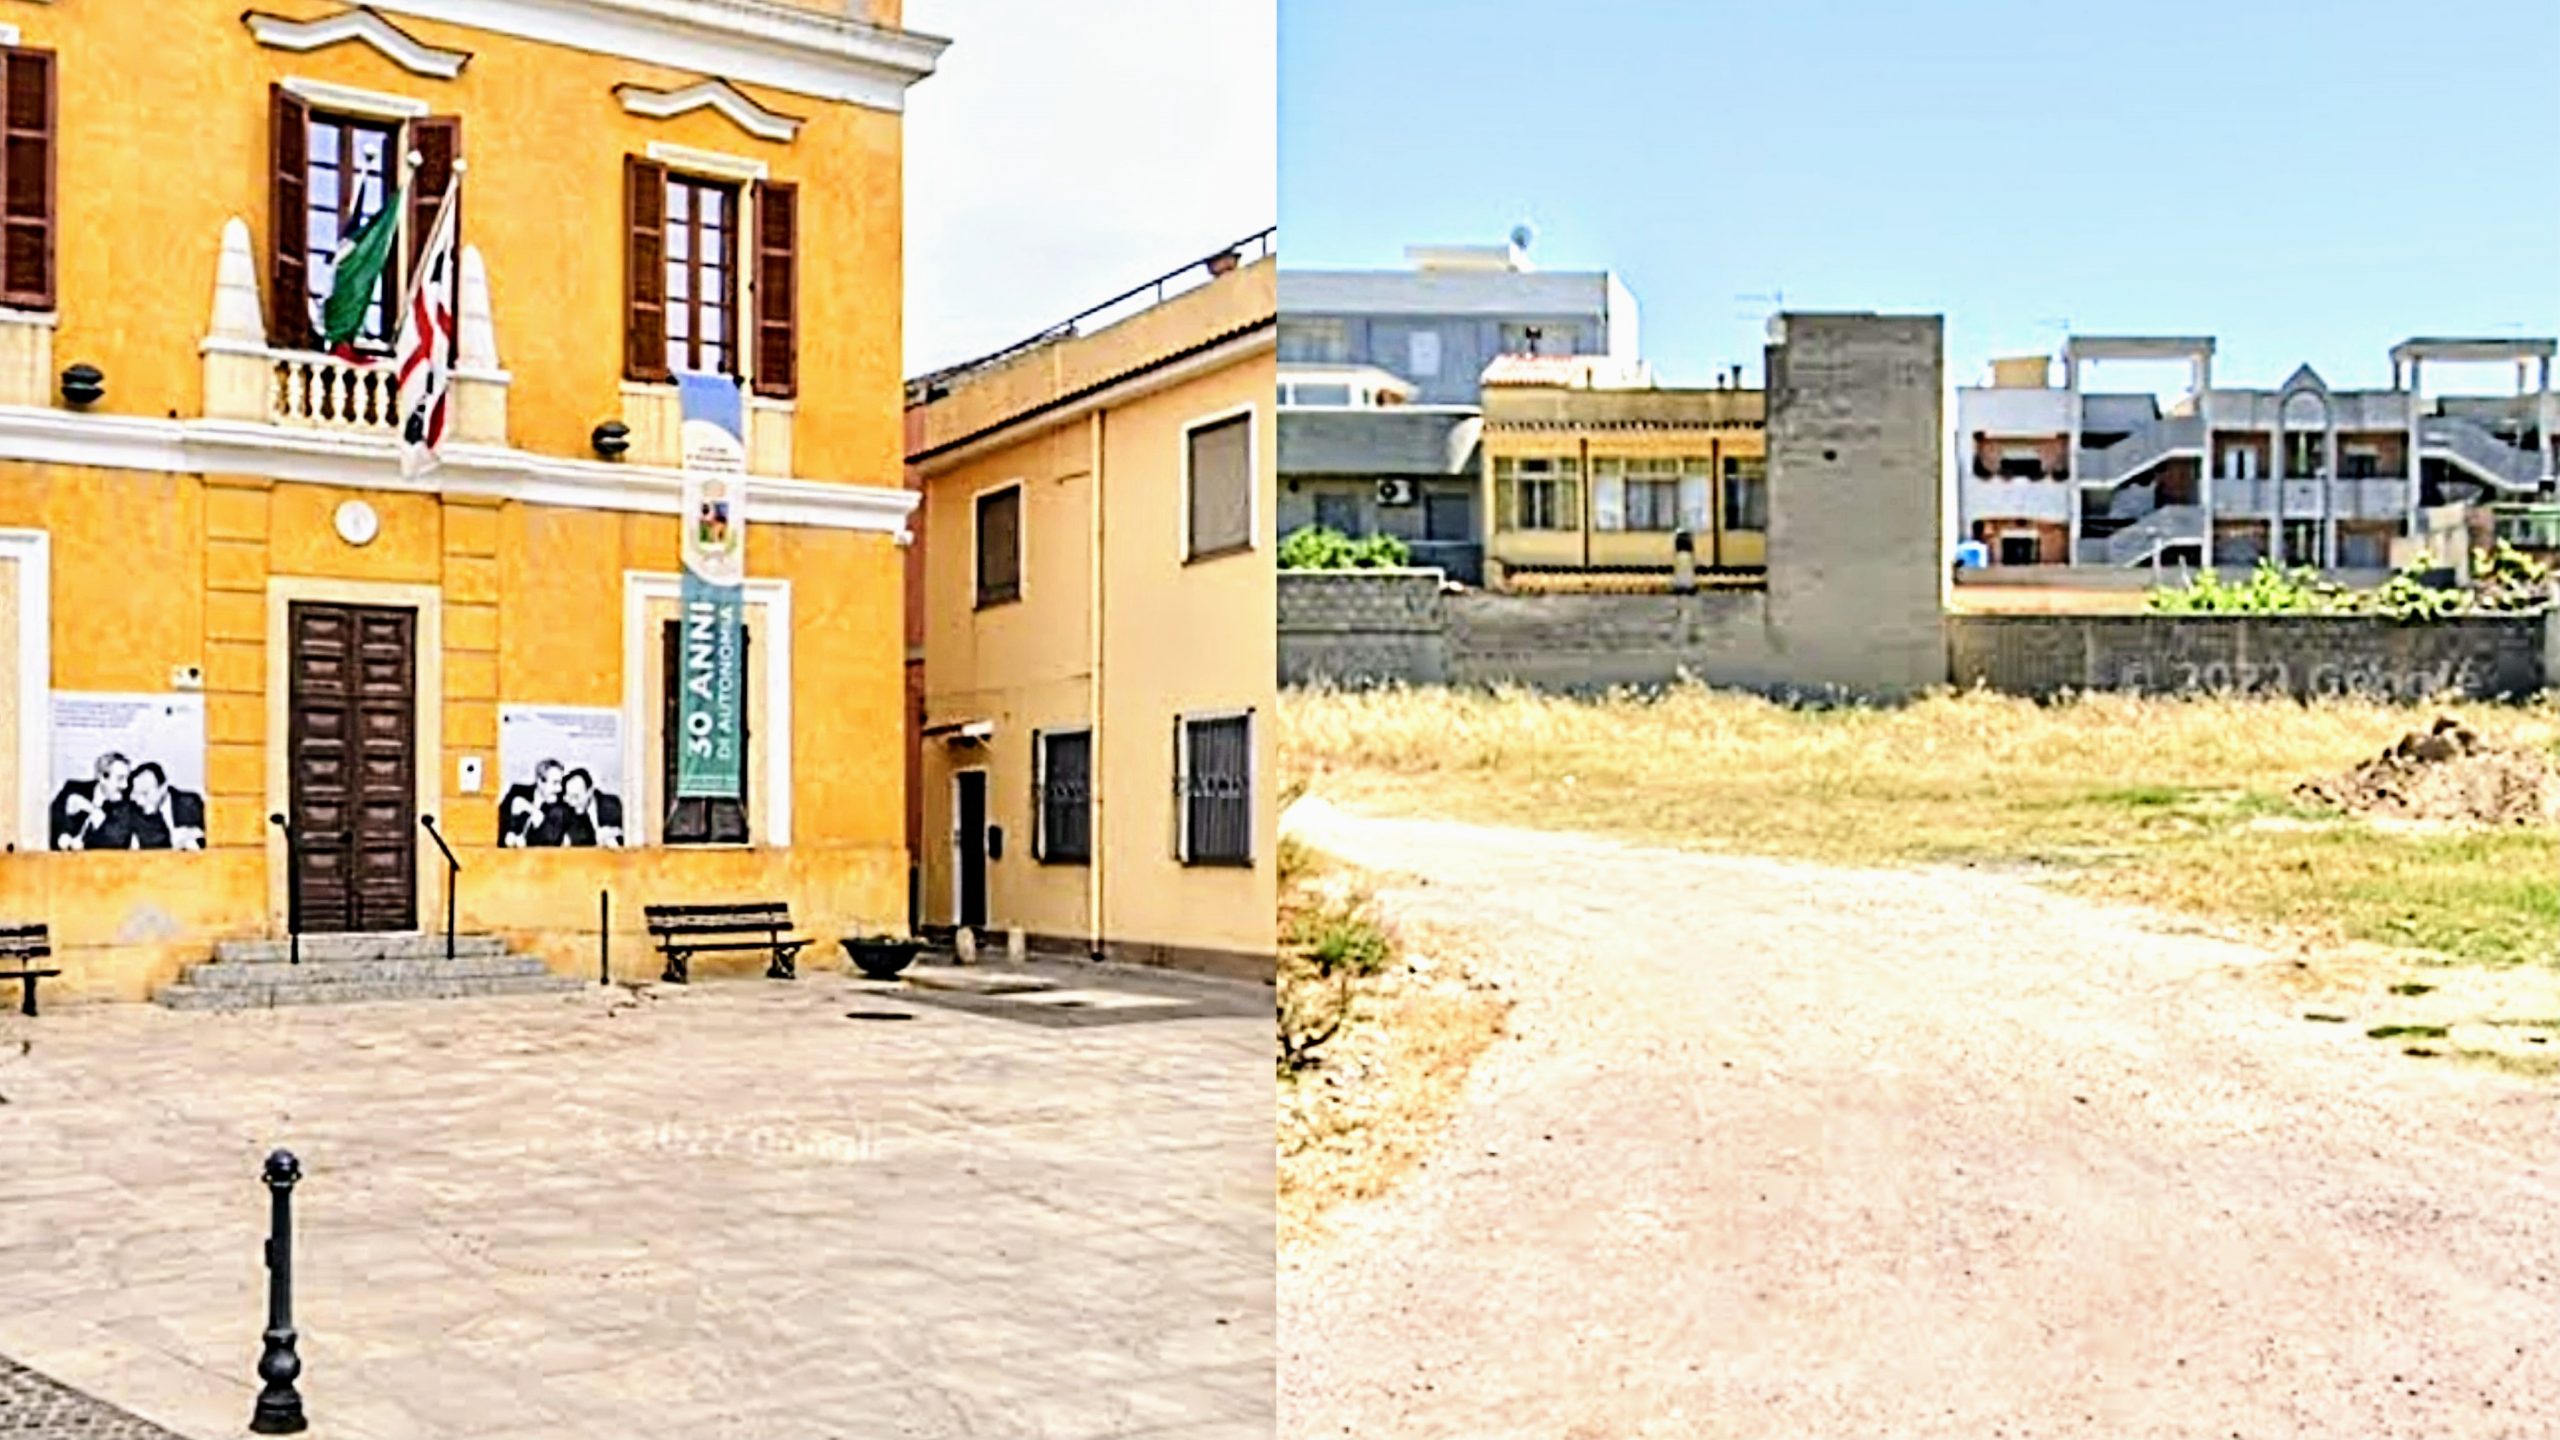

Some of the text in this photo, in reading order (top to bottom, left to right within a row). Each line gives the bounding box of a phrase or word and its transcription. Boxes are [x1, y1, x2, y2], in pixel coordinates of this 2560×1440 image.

[688, 602, 715, 700] ANNI
[717, 606, 734, 760] DI AUTONOMIA
[687, 711, 713, 759] 30
